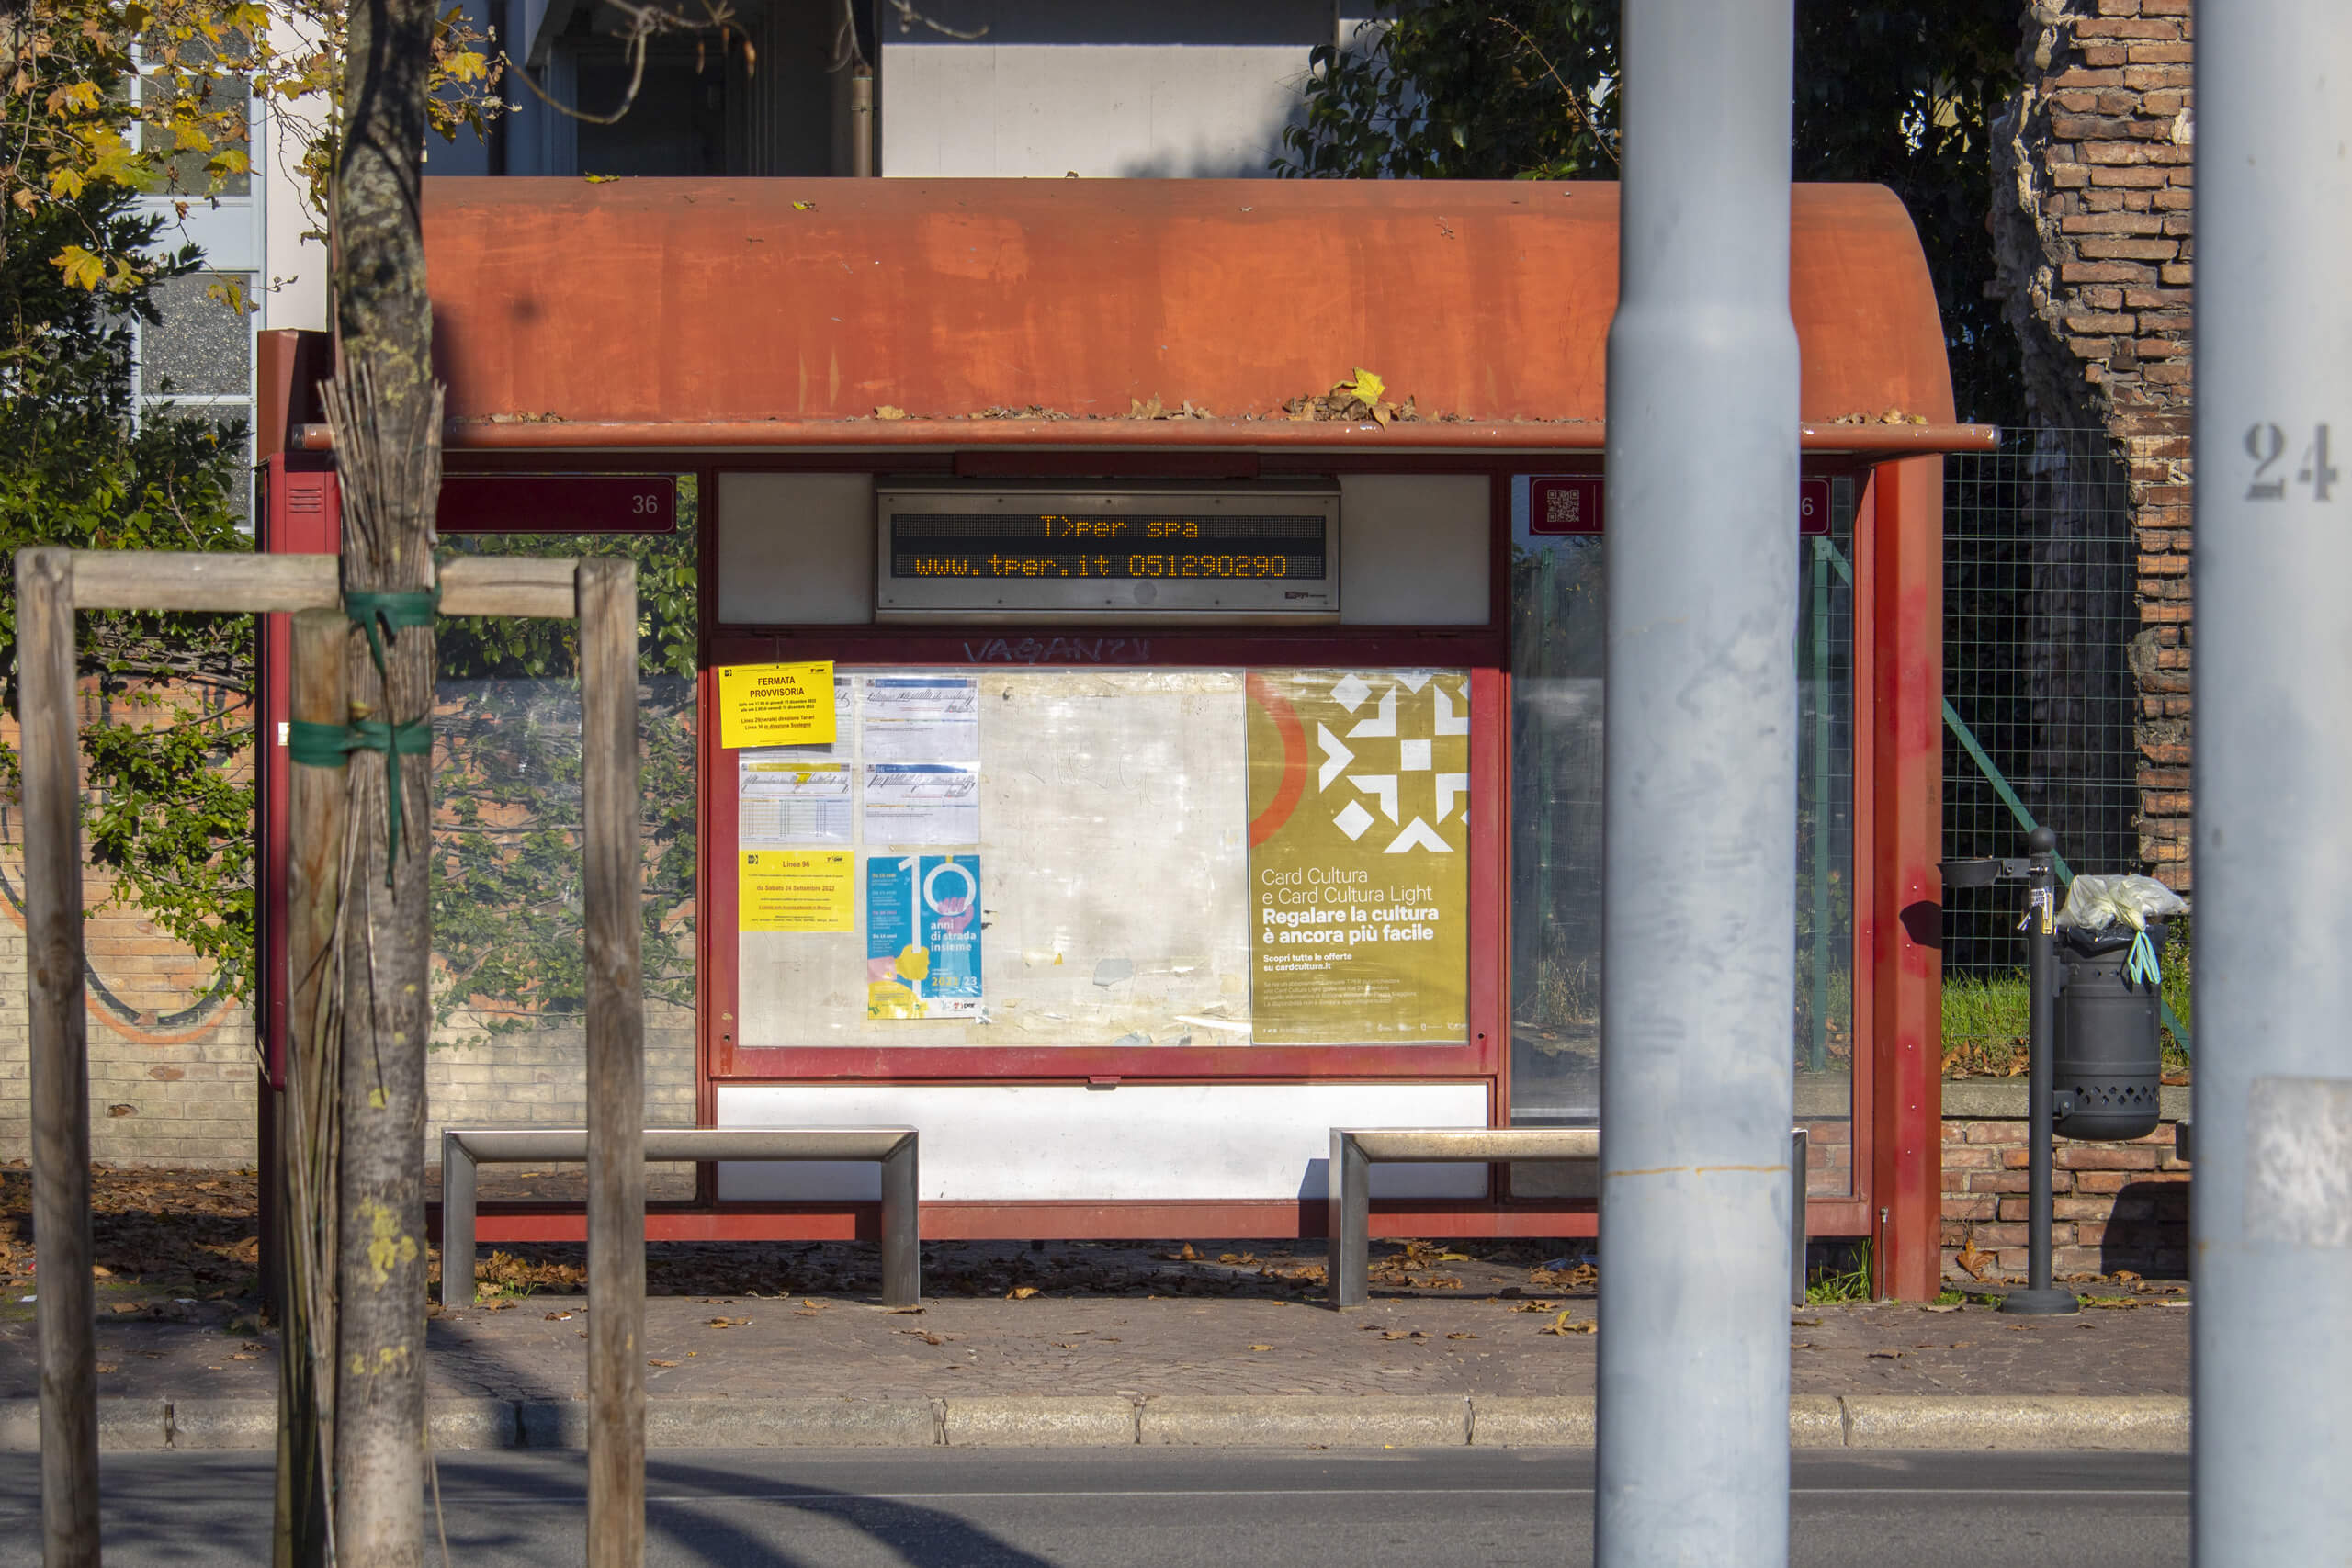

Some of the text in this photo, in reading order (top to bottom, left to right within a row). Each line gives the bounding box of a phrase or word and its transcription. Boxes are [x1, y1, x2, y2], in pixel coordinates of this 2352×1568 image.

[2244, 423, 2338, 502] 24
[631, 494, 659, 515] 36
[1147, 519, 1199, 538] spa
[915, 553, 1287, 577] www.tper.it 051290290
[757, 676, 796, 686] FERMATA
[750, 687, 805, 698] PROVVISORIA
[1261, 866, 1368, 886] Card Cultura
[1262, 885, 1433, 906] e Card Cultura Light
[930, 919, 955, 930] anni
[1262, 905, 1440, 927] Regalare la cultura
[931, 931, 977, 941] di strada
[1262, 924, 1434, 946] è ancora più facile
[931, 942, 972, 952] insieme
[1263, 953, 1352, 964] Scopri tutte le offerte
[1275, 963, 1331, 972] cardcultura.it
